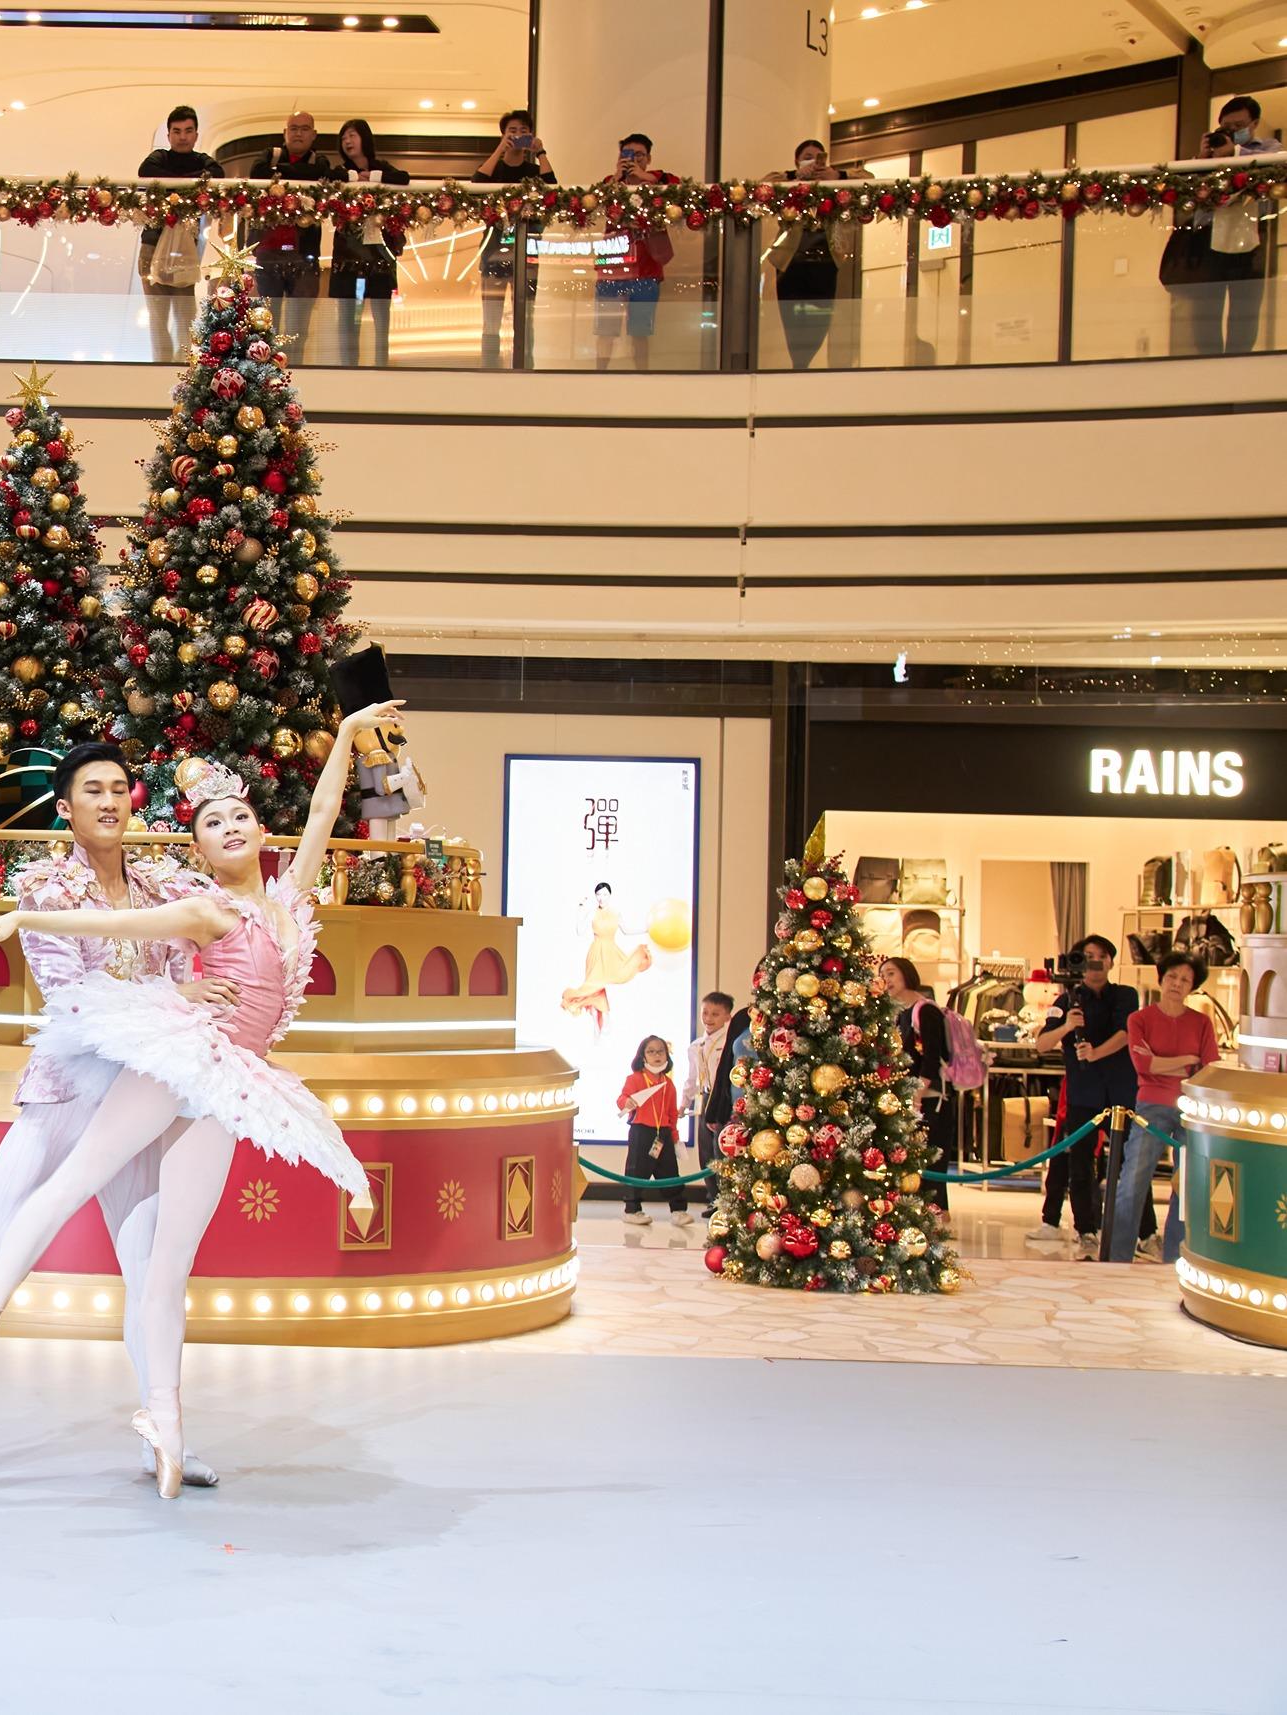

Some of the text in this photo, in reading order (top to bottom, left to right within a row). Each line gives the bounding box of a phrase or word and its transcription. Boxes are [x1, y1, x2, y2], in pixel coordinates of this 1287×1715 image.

[807, 9, 828, 56] L3
[1089, 748, 1244, 798] RAINS
[584, 798, 619, 850] 彈
